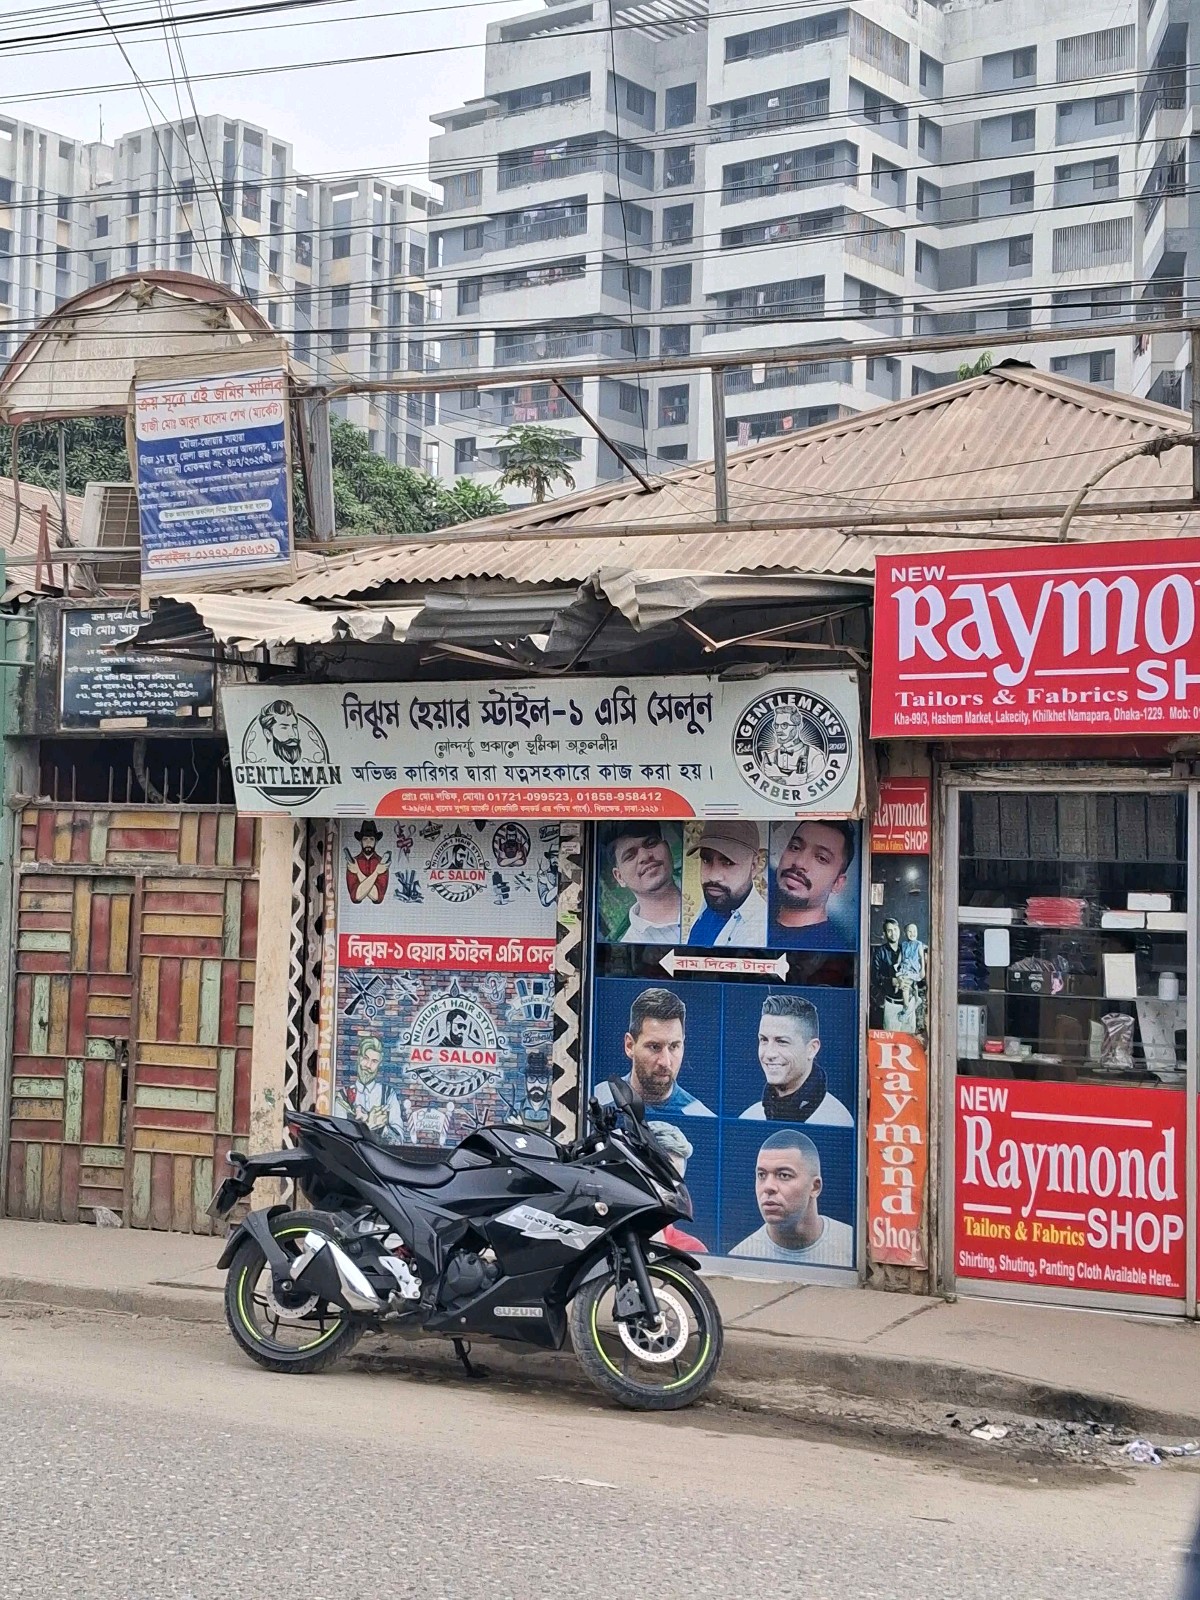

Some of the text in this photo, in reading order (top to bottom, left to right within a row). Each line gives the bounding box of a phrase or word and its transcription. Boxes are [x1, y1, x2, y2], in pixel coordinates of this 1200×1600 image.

[191, 386, 208, 403] এই
[214, 381, 244, 400] জমির
[248, 376, 284, 396] মালিক
[891, 566, 946, 583] NEW
[69, 623, 93, 637] হাজী
[96, 625, 116, 635] মোঃ
[890, 574, 1200, 687] Raymo
[895, 690, 983, 707] Tailors
[992, 689, 1016, 704] &
[1027, 686, 1128, 704] Fabrics
[341, 691, 400, 740] নিঝুম
[410, 696, 471, 730] হেয়ার
[594, 685, 637, 725] এসি
[648, 691, 712, 735] সেলুন
[739, 694, 842, 737] GENTLEMEN'S
[931, 711, 963, 724] Hashem
[965, 711, 993, 725] Market,
[996, 710, 1030, 726] Lakecity,
[1033, 708, 1066, 723] Khilkhet
[1068, 708, 1111, 724] Namapara,
[1114, 707, 1165, 721] Dhaka-1229.
[1169, 706, 1190, 720] Mob:
[480, 738, 520, 758] প্রকাশে
[525, 734, 560, 756] ভূমিকা
[565, 733, 618, 755] অতুলনীয়
[235, 764, 342, 786] GENTLEMAN
[352, 761, 398, 782] অভিজ্ঞ
[404, 760, 458, 783] কারিগর
[465, 764, 497, 783] দ্বারা
[598, 762, 632, 781] কাজ
[639, 762, 670, 782] করা
[742, 759, 841, 801] BARBER SHOP
[488, 792, 573, 802] 01721-099523,
[577, 791, 662, 801] 01858-958412
[904, 830, 928, 851] SHOP
[430, 870, 486, 881] AC SALON
[347, 935, 403, 965] নিঝুম-১
[407, 938, 445, 963] হেয়ার
[449, 938, 493, 964] স্টাইল
[495, 940, 523, 963] এসি
[676, 957, 777, 974] বাম দিকে টানুন
[319, 994, 334, 1071] STYLE
[413, 1002, 495, 1046] NIJHUM-1 HAIR STYLE
[873, 1031, 895, 1040] NEW
[411, 1049, 497, 1065] AC SALON
[315, 1077, 331, 1116] AC
[960, 1085, 1008, 1113] NEW
[873, 1042, 923, 1215] Raymond
[962, 1115, 1178, 1218] Raymond
[872, 1216, 922, 1262] Shop
[964, 1208, 1184, 1254] Tailors & Fabrics SHOP
[959, 1251, 1180, 1288] Shirting, Shuting, Panting Cloth Available Here...
[495, 1307, 542, 1317] SUZUKI
